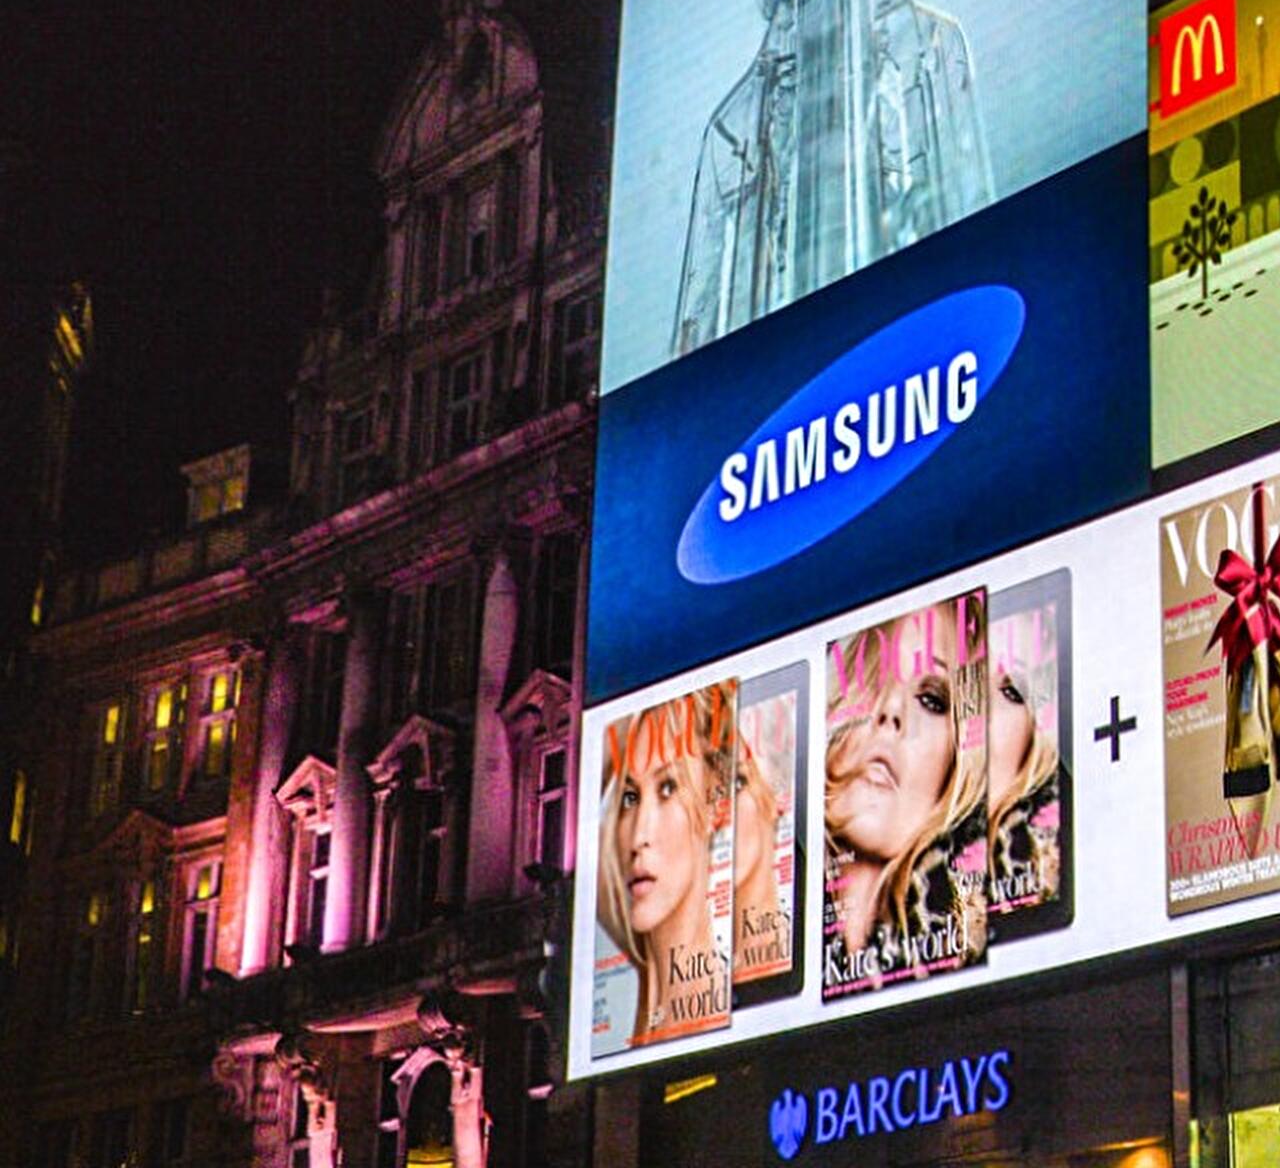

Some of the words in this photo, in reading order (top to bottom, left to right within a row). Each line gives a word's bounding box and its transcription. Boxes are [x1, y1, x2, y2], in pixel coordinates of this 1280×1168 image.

[718, 351, 978, 522] SAMSUNG
[902, 910, 968, 971] world
[670, 974, 730, 1023] world
[816, 1051, 1009, 1144] BARCLAYS
